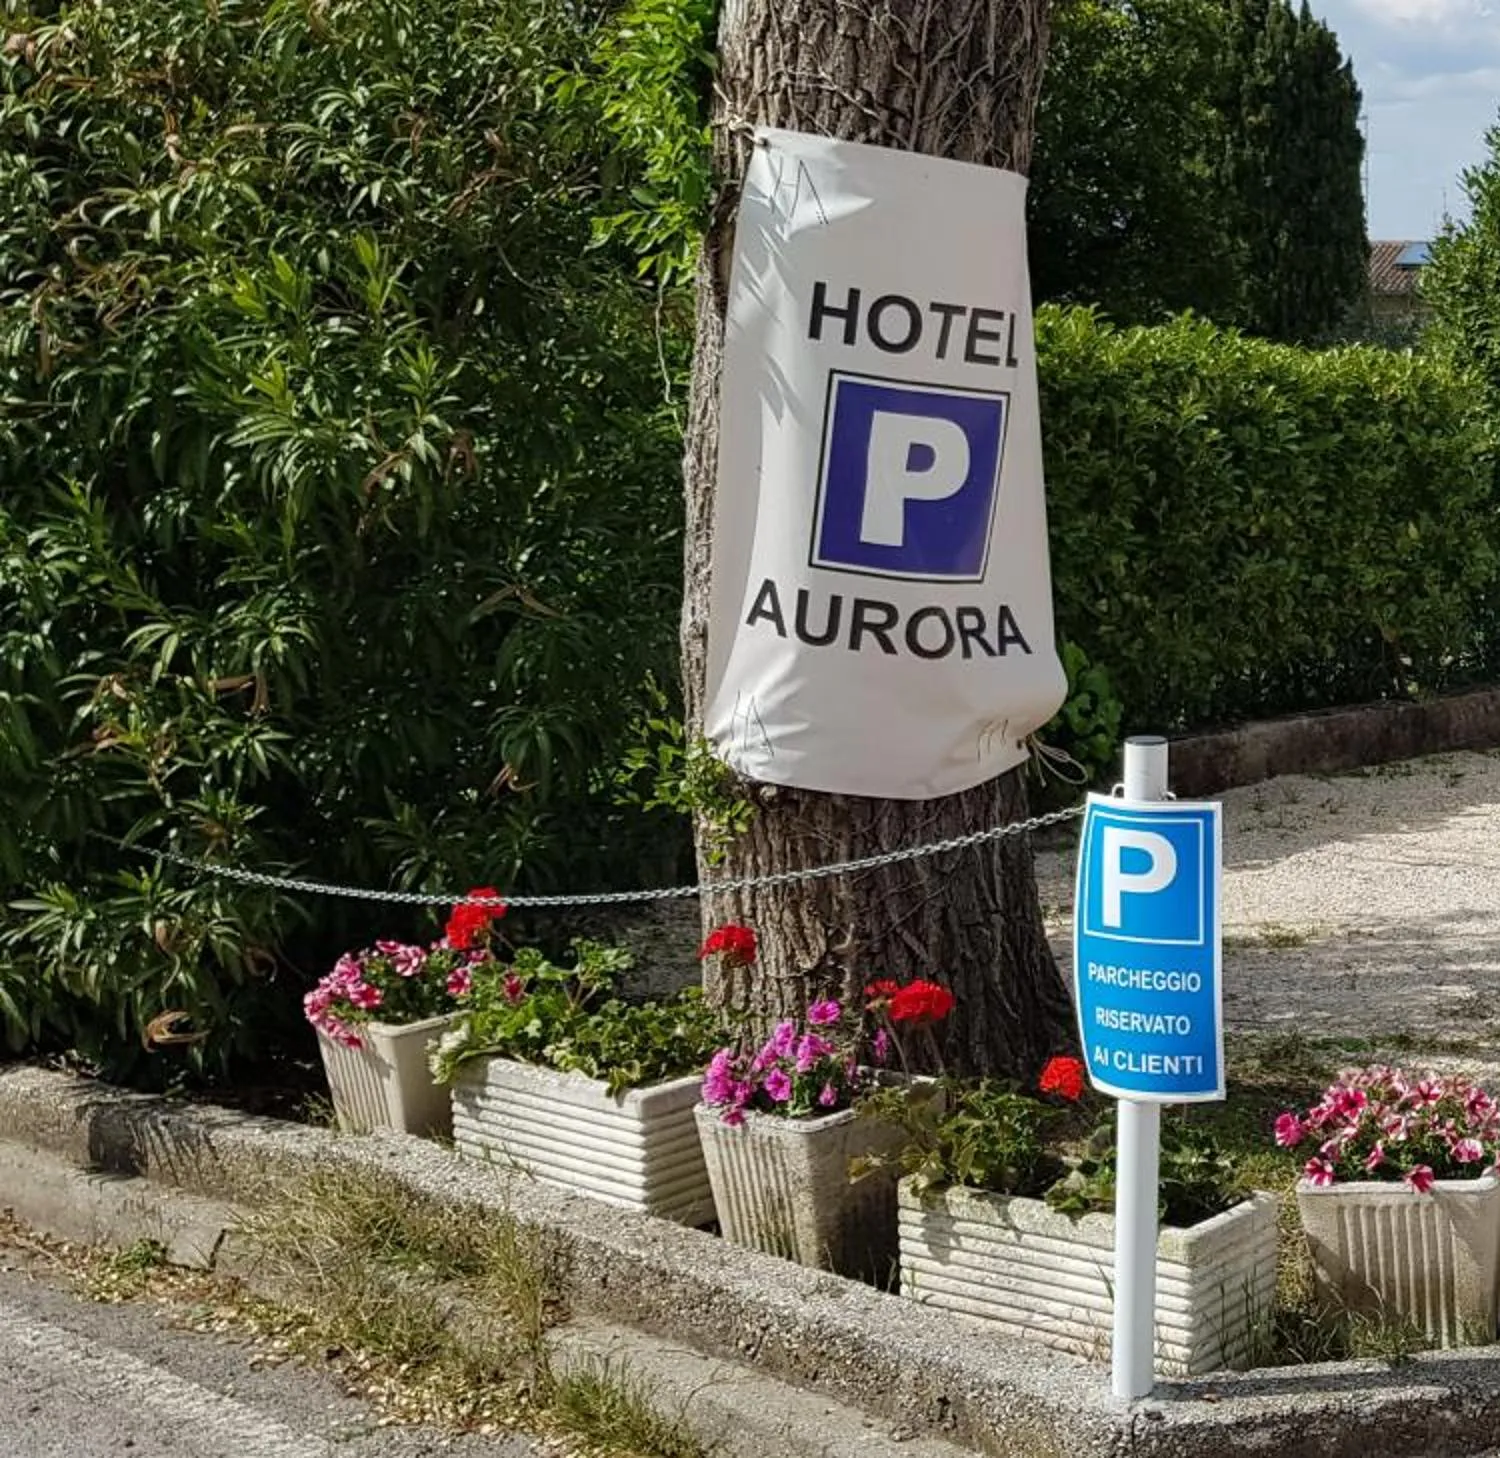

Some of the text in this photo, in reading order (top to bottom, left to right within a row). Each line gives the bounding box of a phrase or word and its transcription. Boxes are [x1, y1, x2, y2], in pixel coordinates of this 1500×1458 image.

[808, 280, 1019, 369] HOTEL
[859, 409, 970, 547] P
[745, 578, 1032, 661] AURORA
[1102, 825, 1178, 928] P
[1087, 961, 1201, 993] PARCHEGGIO
[1093, 1045, 1203, 1075] AI CLIENTI
[1095, 1006, 1190, 1036] RISERVATO
